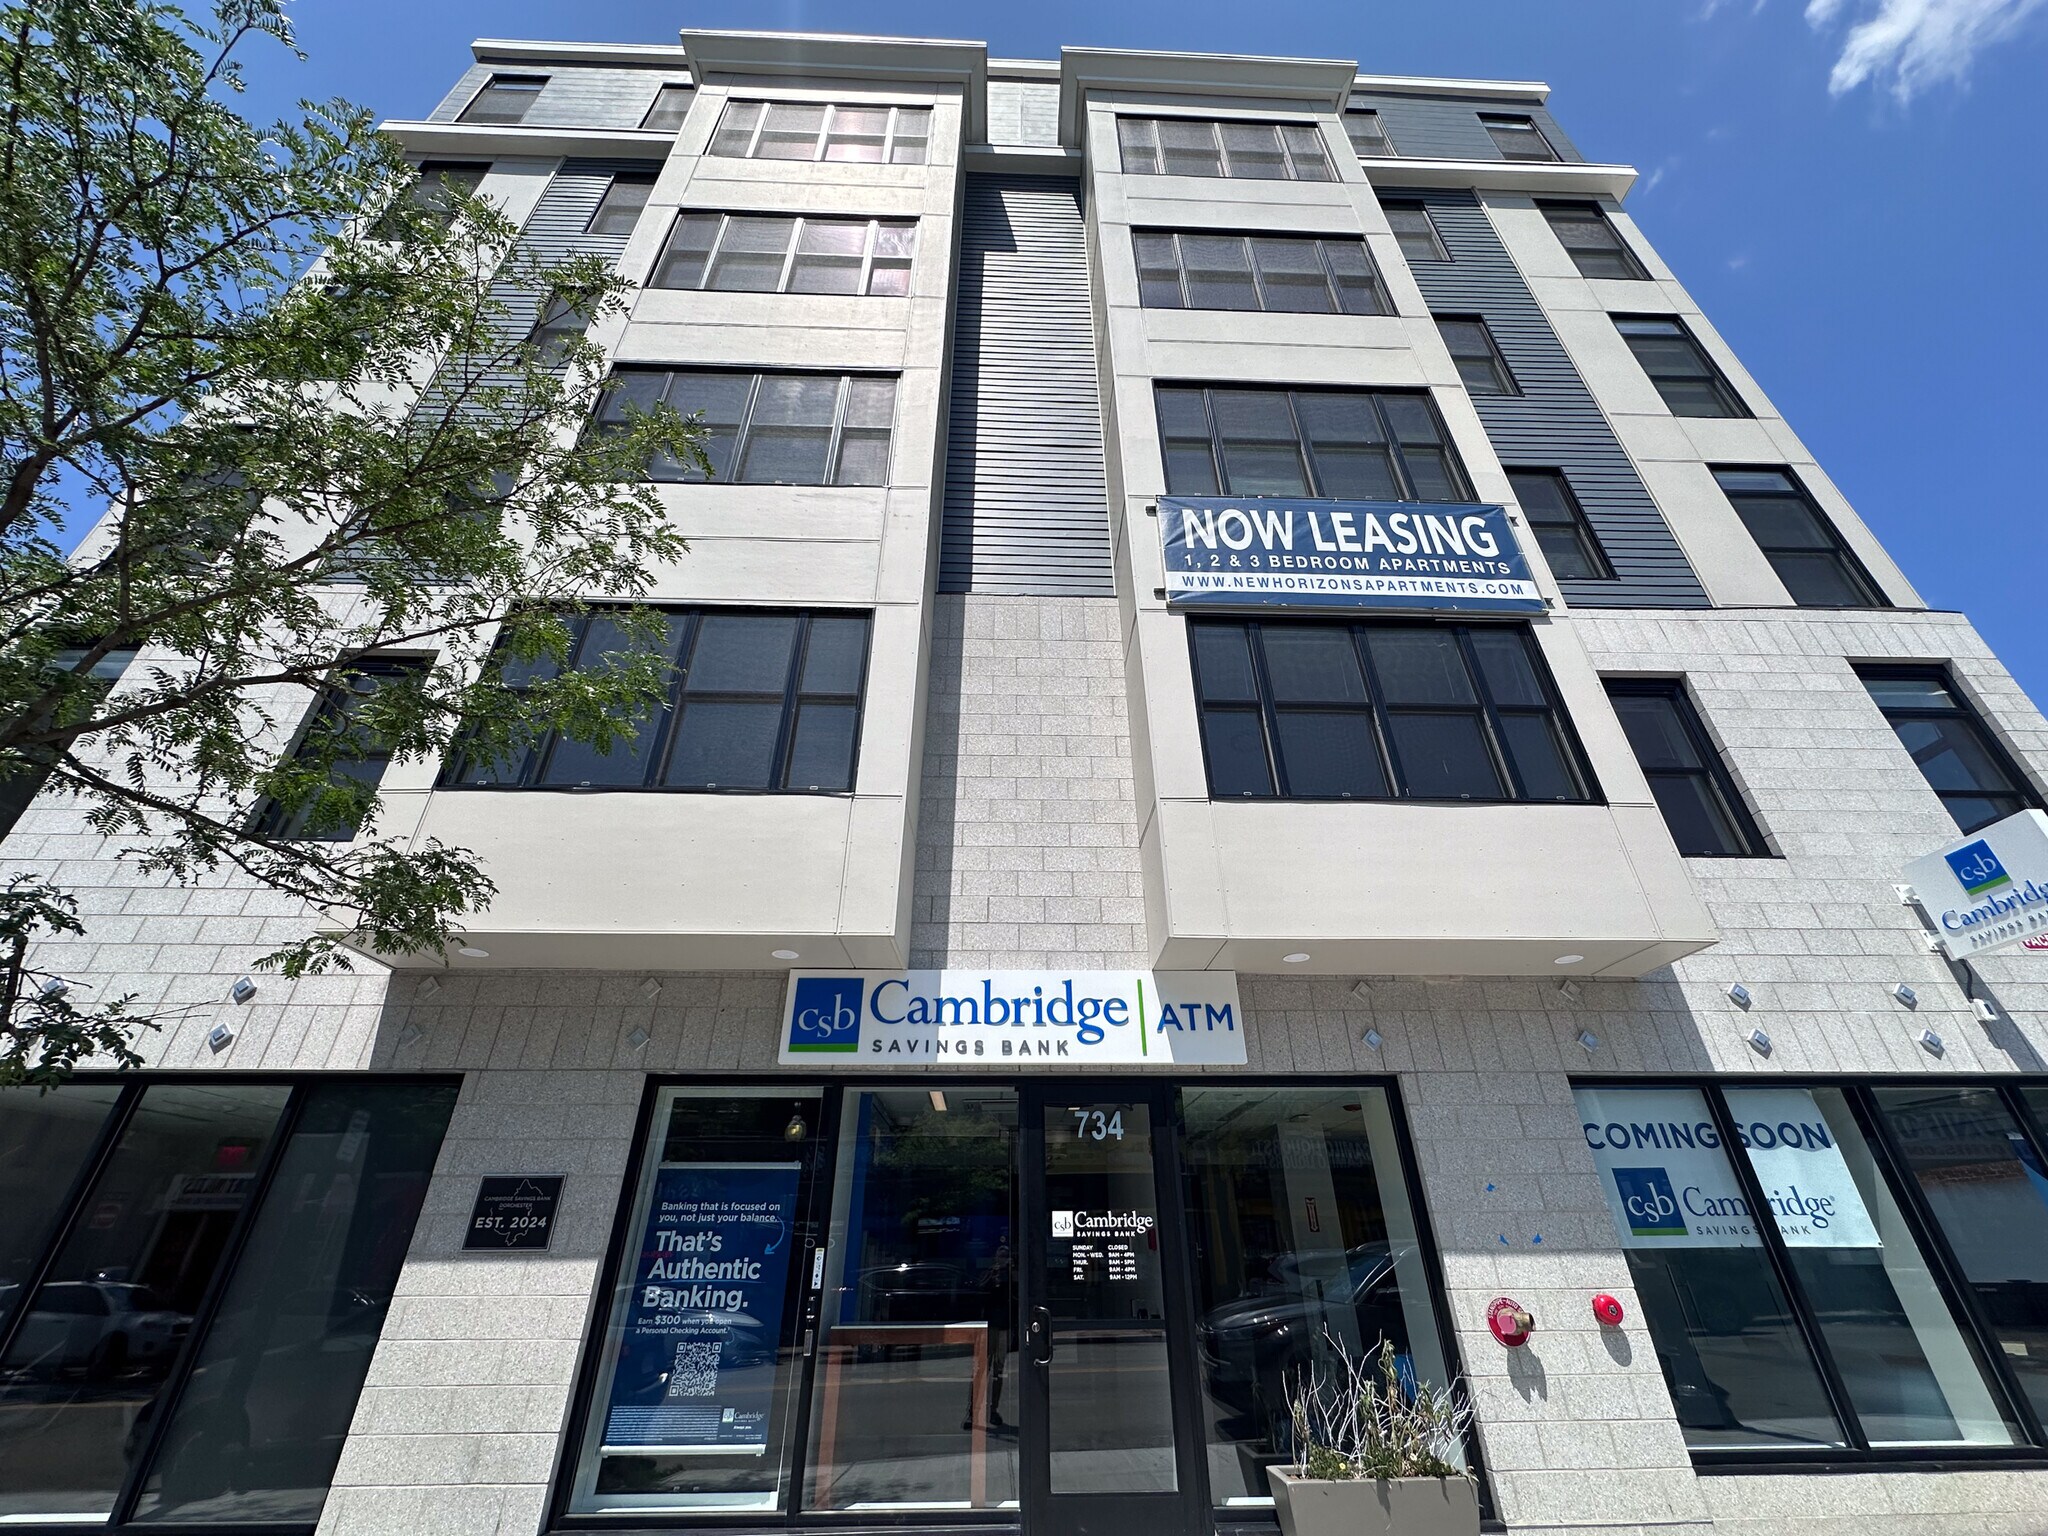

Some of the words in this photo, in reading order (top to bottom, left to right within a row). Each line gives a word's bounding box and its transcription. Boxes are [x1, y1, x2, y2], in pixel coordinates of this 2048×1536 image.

[1181, 509, 1293, 551] NOW
[1307, 511, 1500, 557] LEASING
[1184, 555, 1201, 568] 1,
[1210, 555, 1220, 567] 2
[1229, 555, 1241, 567] &
[1250, 555, 1260, 567] 3
[1268, 555, 1369, 570] BEDROOM
[1379, 557, 1511, 575] APARTMENTS
[1182, 576, 1524, 595] WWW.NEWHORIZONSAPARTMENTS.COM
[1960, 853, 1997, 881] csb
[1970, 920, 2022, 942] SAVINGS
[798, 994, 855, 1039] csb
[869, 979, 1129, 1045] Cambridge
[1157, 1004, 1235, 1033] ATM
[872, 1038, 984, 1056] SAVINGS
[1002, 1040, 1070, 1056] BANK
[1074, 1110, 1124, 1141] 734
[1583, 1122, 1721, 1150] COMING
[1735, 1122, 1832, 1149] SOON
[661, 1202, 698, 1212] Banking
[700, 1202, 719, 1211] that
[721, 1202, 729, 1211] is
[731, 1202, 766, 1211] focused
[1627, 1183, 1674, 1222] csb
[1683, 1185, 1836, 1229] Camridge
[475, 1217, 504, 1228] EST.
[510, 1216, 547, 1228] 2024
[659, 1214, 678, 1223] you,
[681, 1214, 696, 1222] not
[698, 1213, 715, 1223] just
[717, 1215, 738, 1223] your
[741, 1213, 778, 1222] balance.
[1054, 1216, 1071, 1231] csb
[1074, 1210, 1153, 1234] Cambridge
[656, 1230, 722, 1252] That's
[1696, 1226, 1758, 1236] SAVINGS
[1781, 1226, 1811, 1235] ANK
[647, 1257, 761, 1280] Authentic
[642, 1284, 748, 1312] Banking.
[638, 1317, 653, 1325] Earn
[654, 1315, 681, 1325] $300
[714, 1318, 732, 1326] open
[670, 1327, 699, 1335] Checking
[734, 1411, 765, 1422] Cambridge
